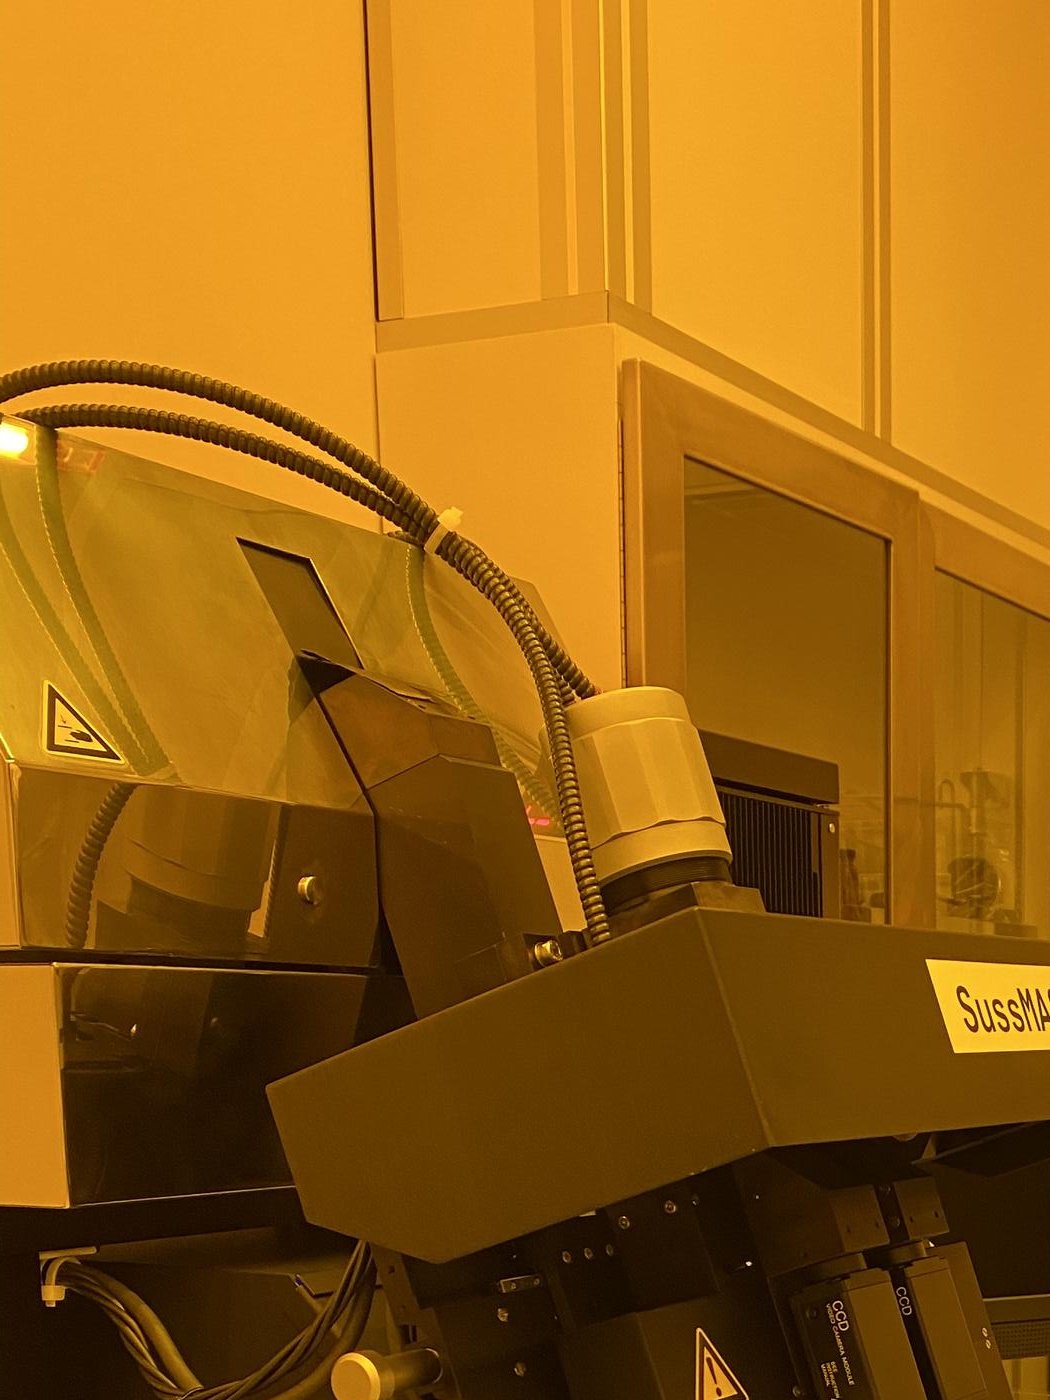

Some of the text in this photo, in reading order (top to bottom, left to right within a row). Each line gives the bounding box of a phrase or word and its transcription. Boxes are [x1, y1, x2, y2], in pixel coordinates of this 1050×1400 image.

[832, 1300, 850, 1332] CCD
[896, 1286, 912, 1316] CCD
[826, 1302, 856, 1386] VIDEO CAMERA MODULE
